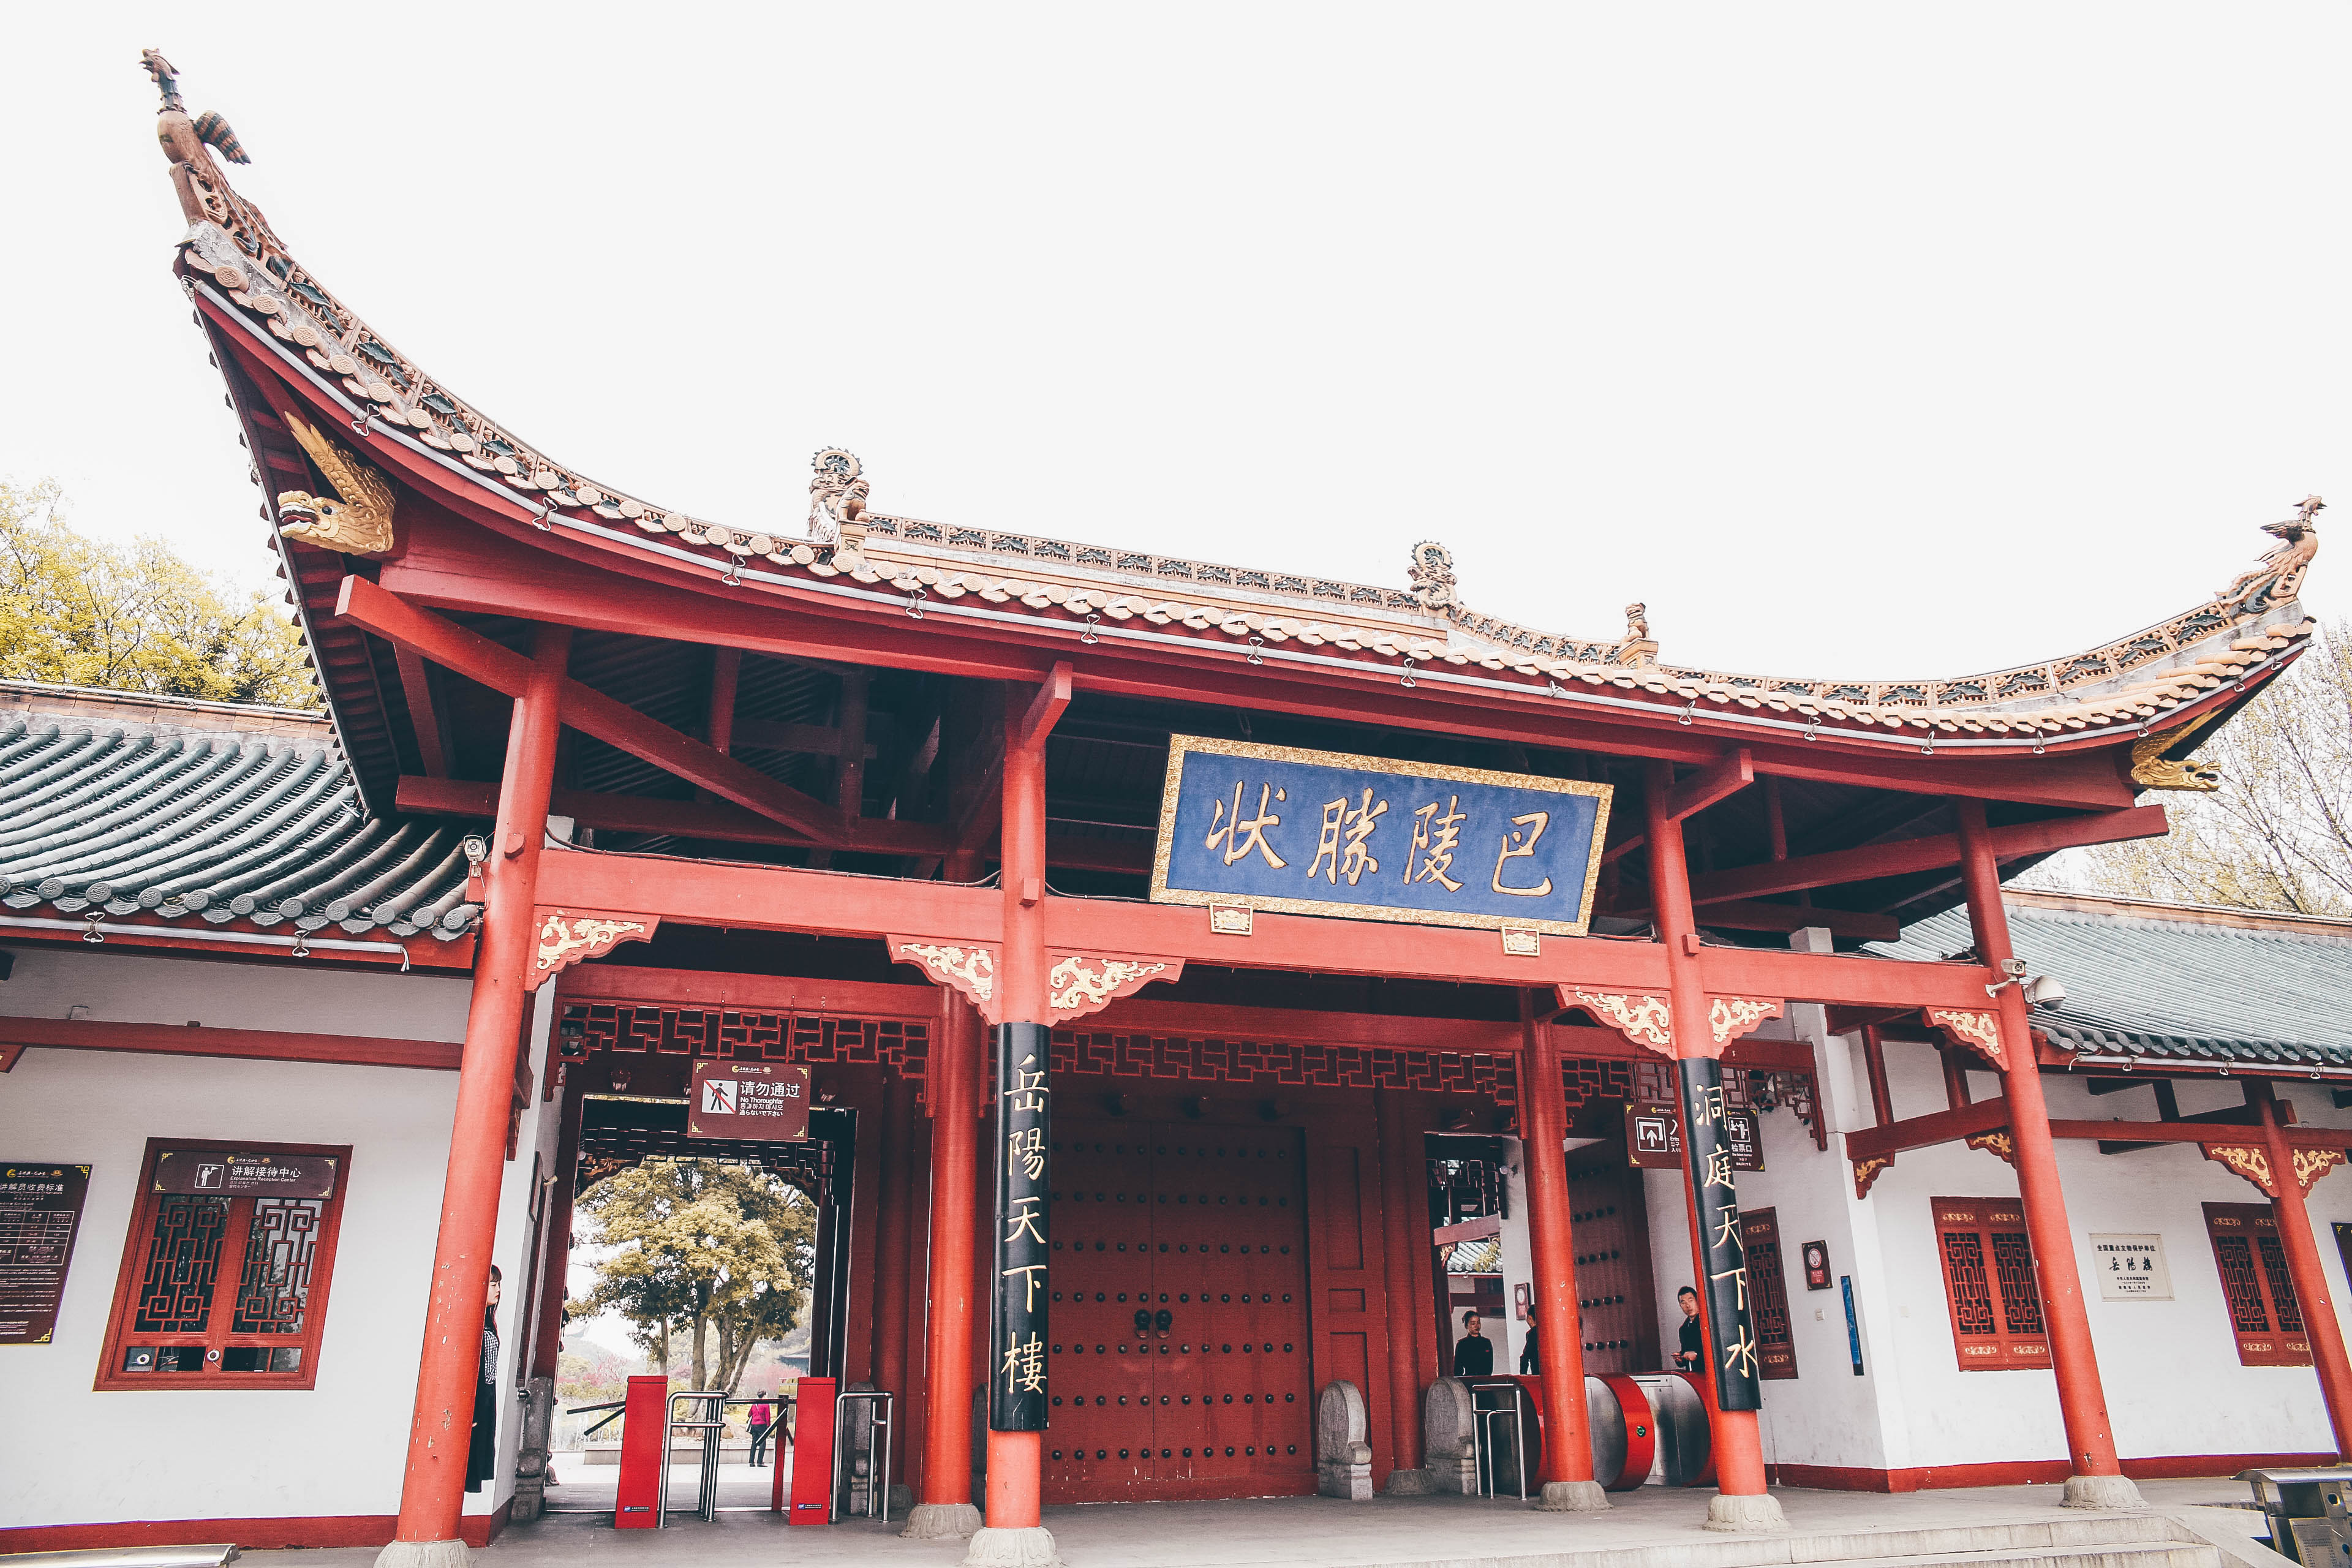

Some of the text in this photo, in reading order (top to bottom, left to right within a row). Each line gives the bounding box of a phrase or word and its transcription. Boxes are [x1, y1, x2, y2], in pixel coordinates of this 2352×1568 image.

[740, 1080, 800, 1098] 请勿通过
[1731, 1143, 1752, 1152] 检票口
[232, 1166, 301, 1178] 讲解接待中心
[0, 1183, 64, 1191] 讲解员收费标准
[1694, 1084, 1758, 1379] 洞庭天下水
